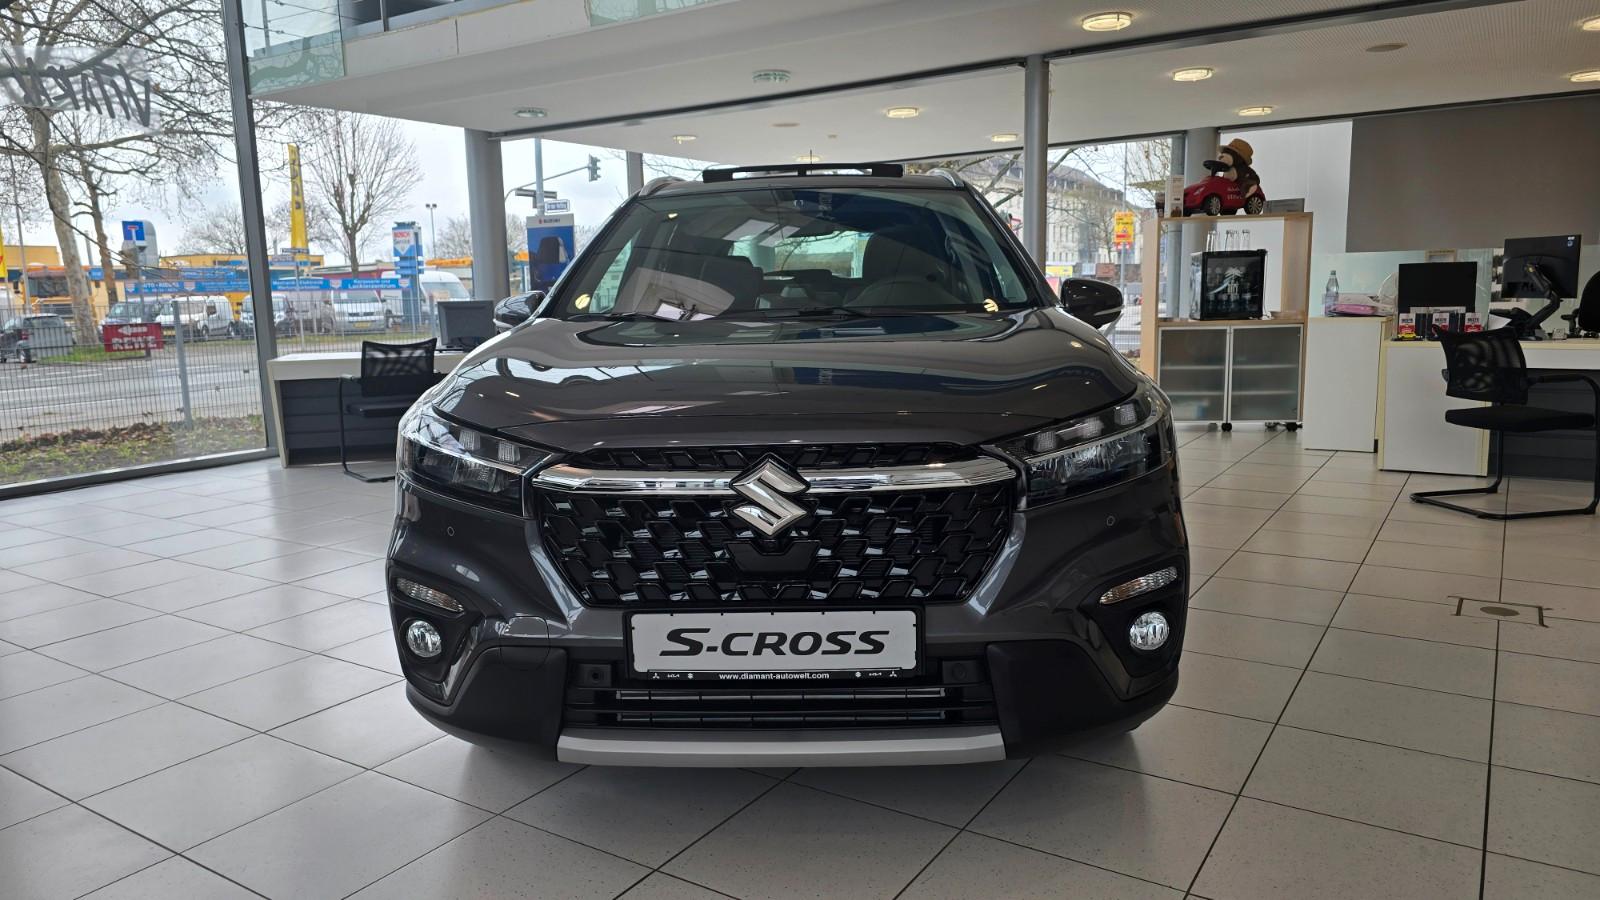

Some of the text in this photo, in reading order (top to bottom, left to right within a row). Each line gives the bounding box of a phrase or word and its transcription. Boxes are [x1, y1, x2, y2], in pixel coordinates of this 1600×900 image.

[112, 336, 157, 350] REWE
[659, 628, 890, 657] S-CROSS
[719, 672, 830, 680] www.diamant-autowelt.com
